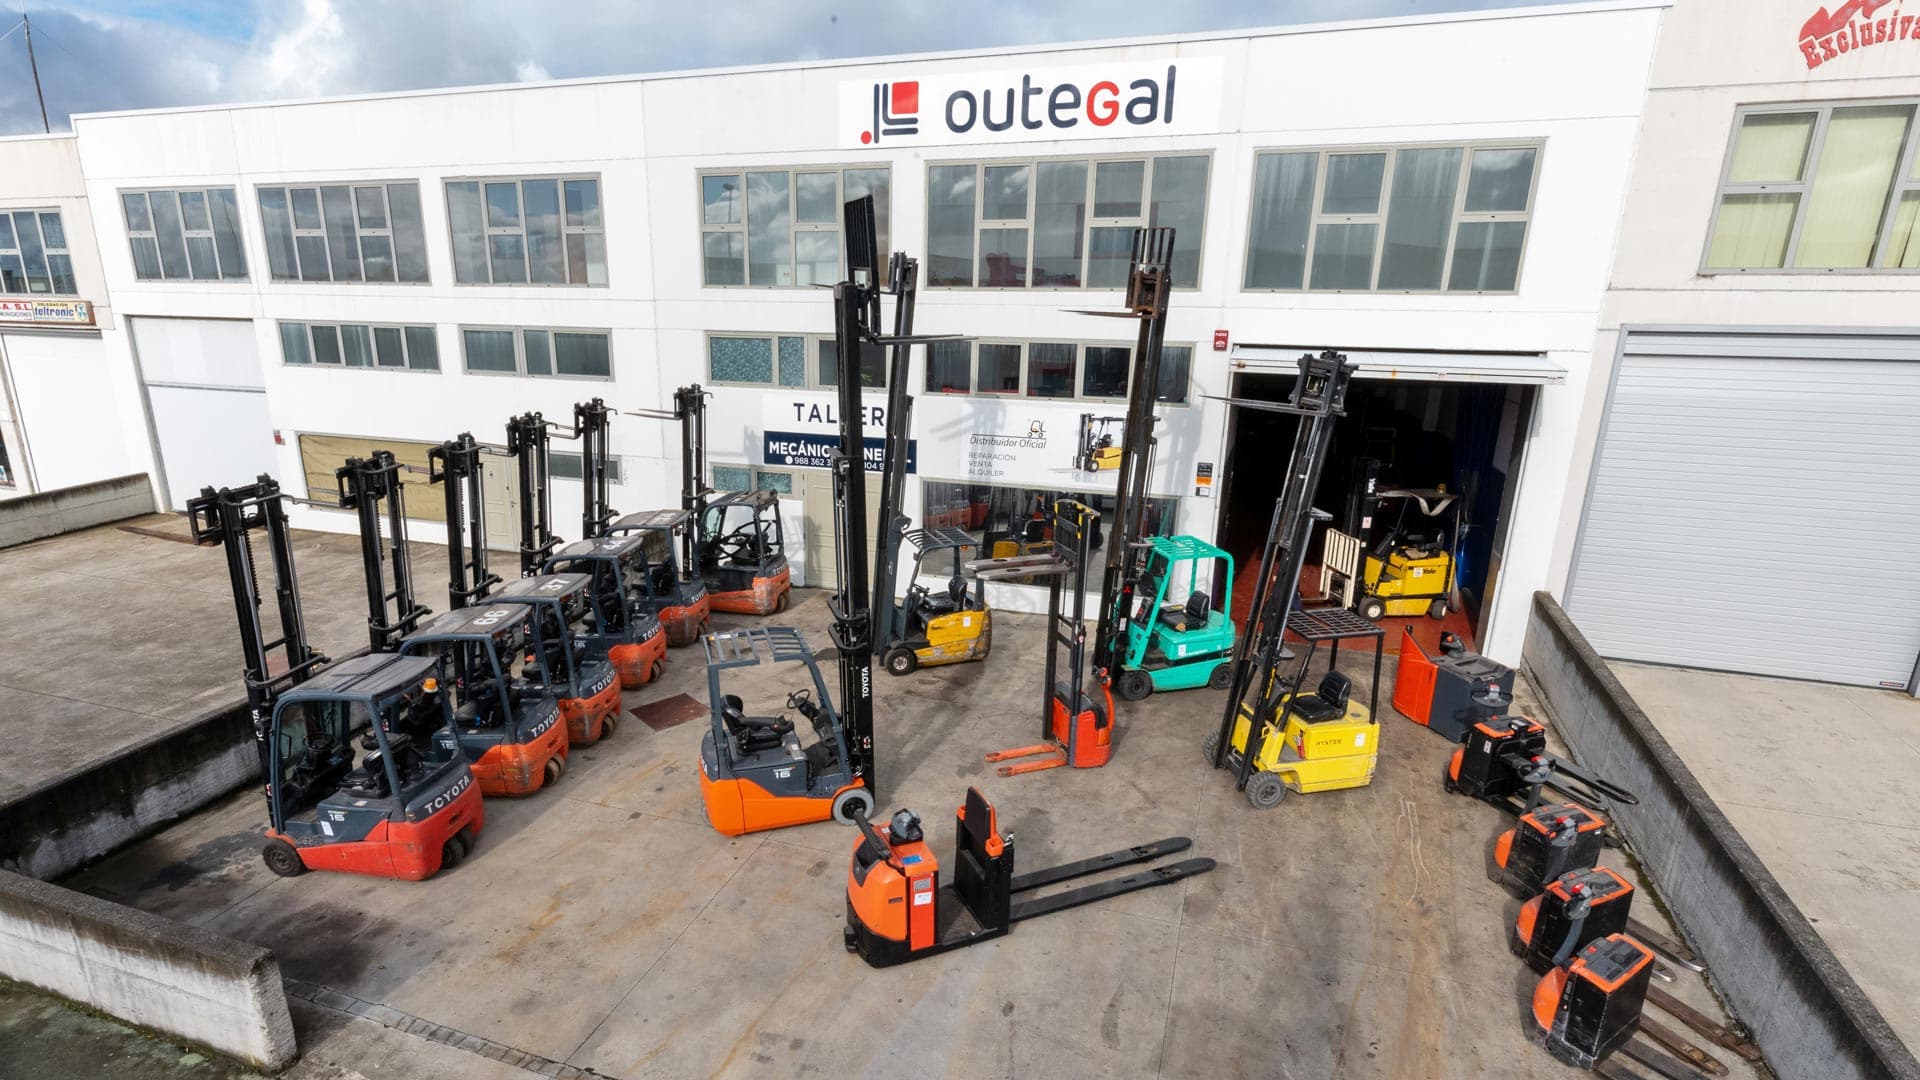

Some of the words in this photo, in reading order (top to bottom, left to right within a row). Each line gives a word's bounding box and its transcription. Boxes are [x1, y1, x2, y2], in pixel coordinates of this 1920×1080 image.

[35, 307, 74, 316] teltronic
[793, 403, 884, 426] TALER
[769, 440, 837, 458] MECÁNIC
[969, 436, 1017, 447] Distribuidor
[1019, 439, 1047, 448] Oficial
[968, 468, 1004, 477] ALQUILER
[540, 578, 571, 591] 37
[473, 610, 510, 626] 66
[862, 666, 870, 698] TOYOTA
[424, 775, 471, 815] TOYOTA
